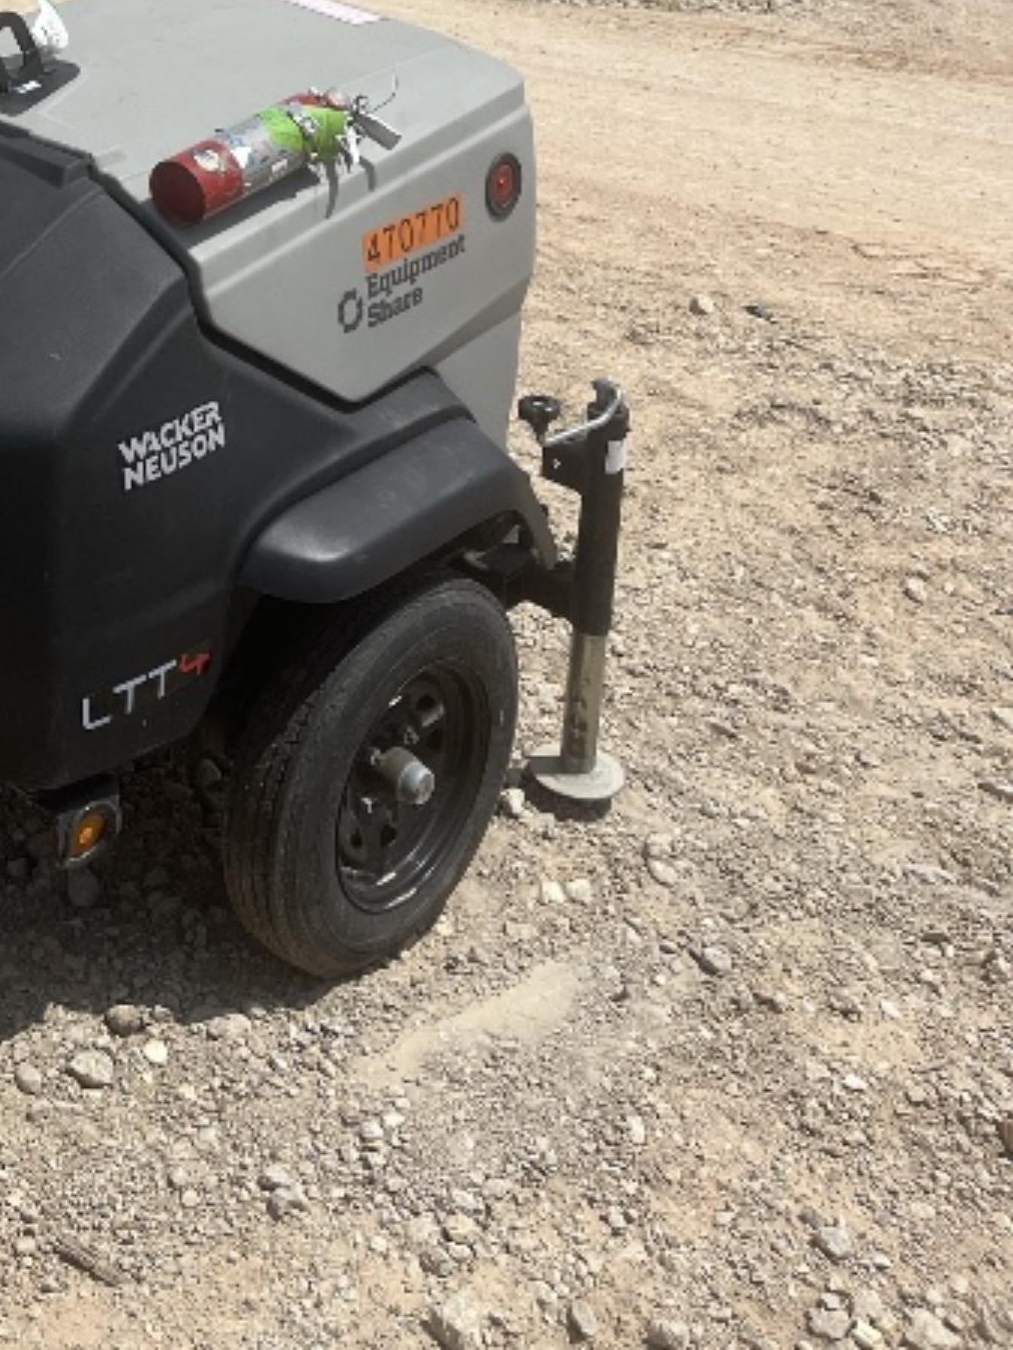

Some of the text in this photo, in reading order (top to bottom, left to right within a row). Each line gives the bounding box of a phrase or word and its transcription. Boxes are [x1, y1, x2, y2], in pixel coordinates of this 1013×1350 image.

[366, 197, 460, 262] 470770
[365, 234, 466, 299] Equipment
[367, 287, 424, 328] Share
[118, 401, 223, 464] WACKER
[123, 422, 226, 491] NEUSON
